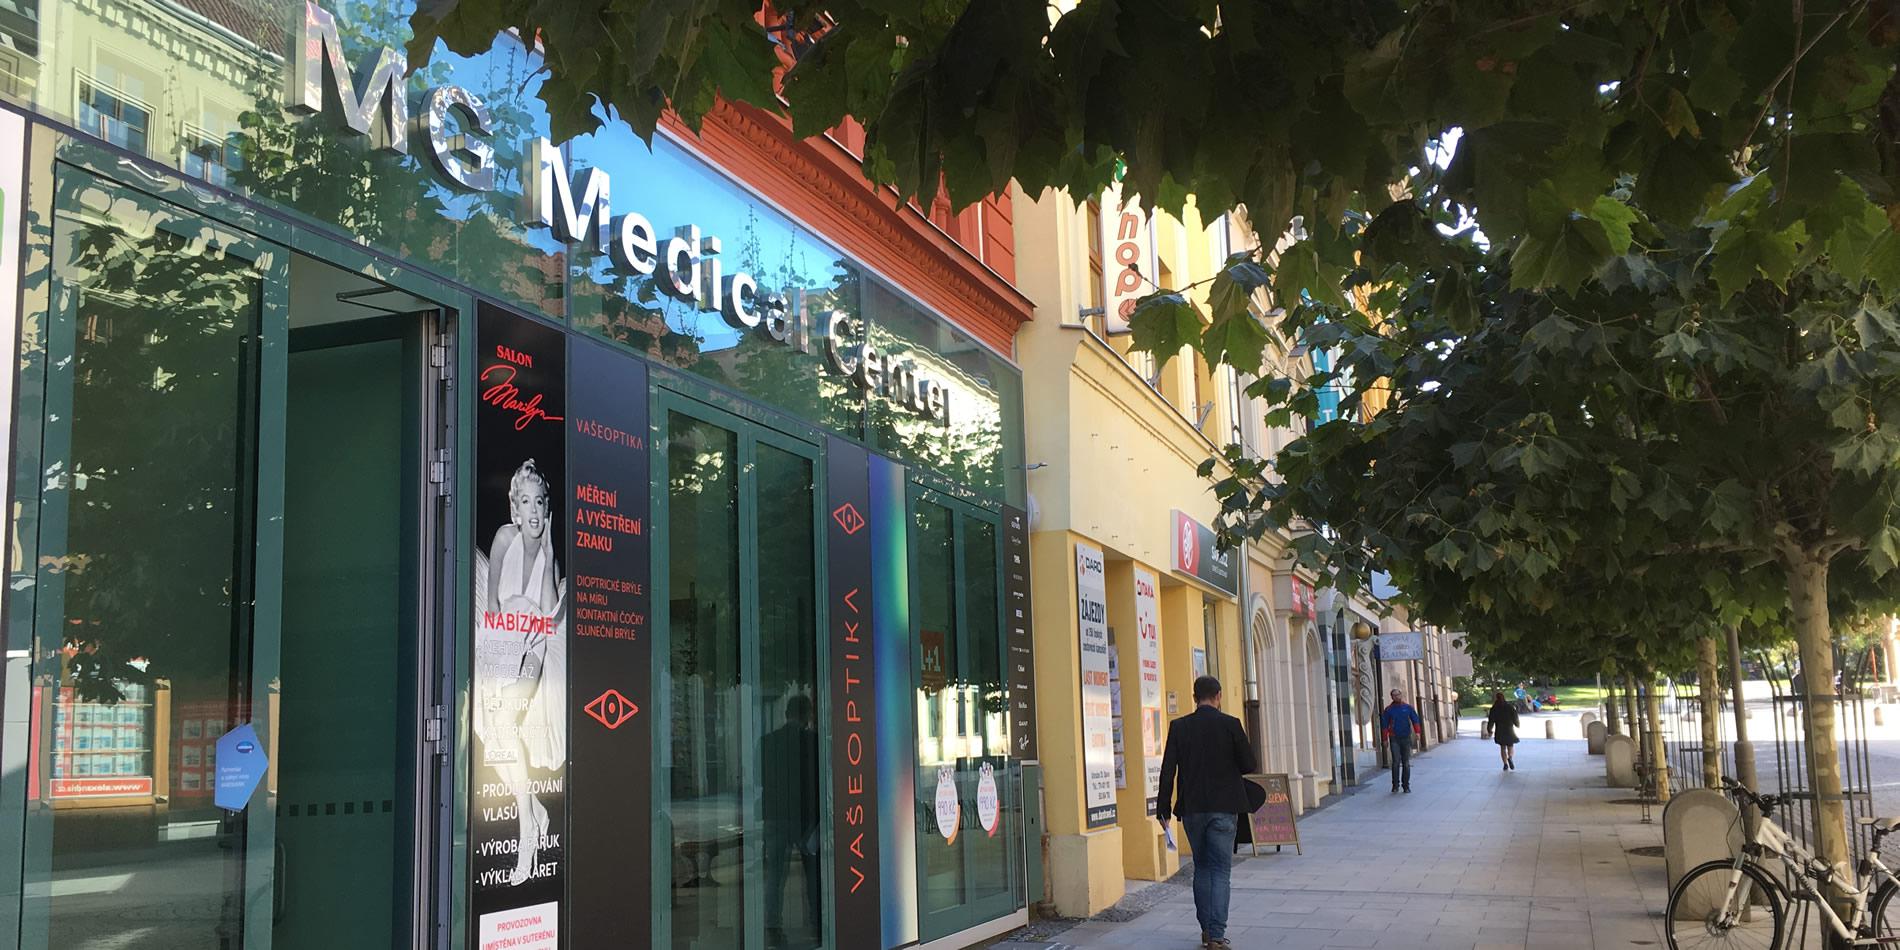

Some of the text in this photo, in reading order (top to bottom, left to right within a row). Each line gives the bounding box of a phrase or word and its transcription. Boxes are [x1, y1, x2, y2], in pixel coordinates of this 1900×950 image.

[289, 0, 494, 192] MG
[526, 136, 809, 354] Medical
[496, 344, 532, 368] SALON
[480, 364, 564, 431] Marilyn
[576, 418, 643, 450] VAŠEOPTIKA
[576, 483, 617, 508] MĚŘENÍ
[576, 508, 641, 536] A VYŠETŘENÍ
[576, 531, 613, 552] ZRAKU
[576, 574, 620, 592] DIOPTRICKÉ
[576, 591, 588, 603] NA
[576, 607, 645, 625] KONTAKTNÍ ČOČKY
[1081, 594, 1105, 625] ZÁJEZDY
[483, 610, 558, 636] NABÍZÍME:
[576, 623, 613, 639] SLUNEČNÍ
[844, 587, 865, 894] VAŠEOPTIKA
[483, 802, 518, 822] VLASŮ
[497, 915, 542, 932] PROVOZOVNA
[522, 928, 555, 945] SUTERÉNU
